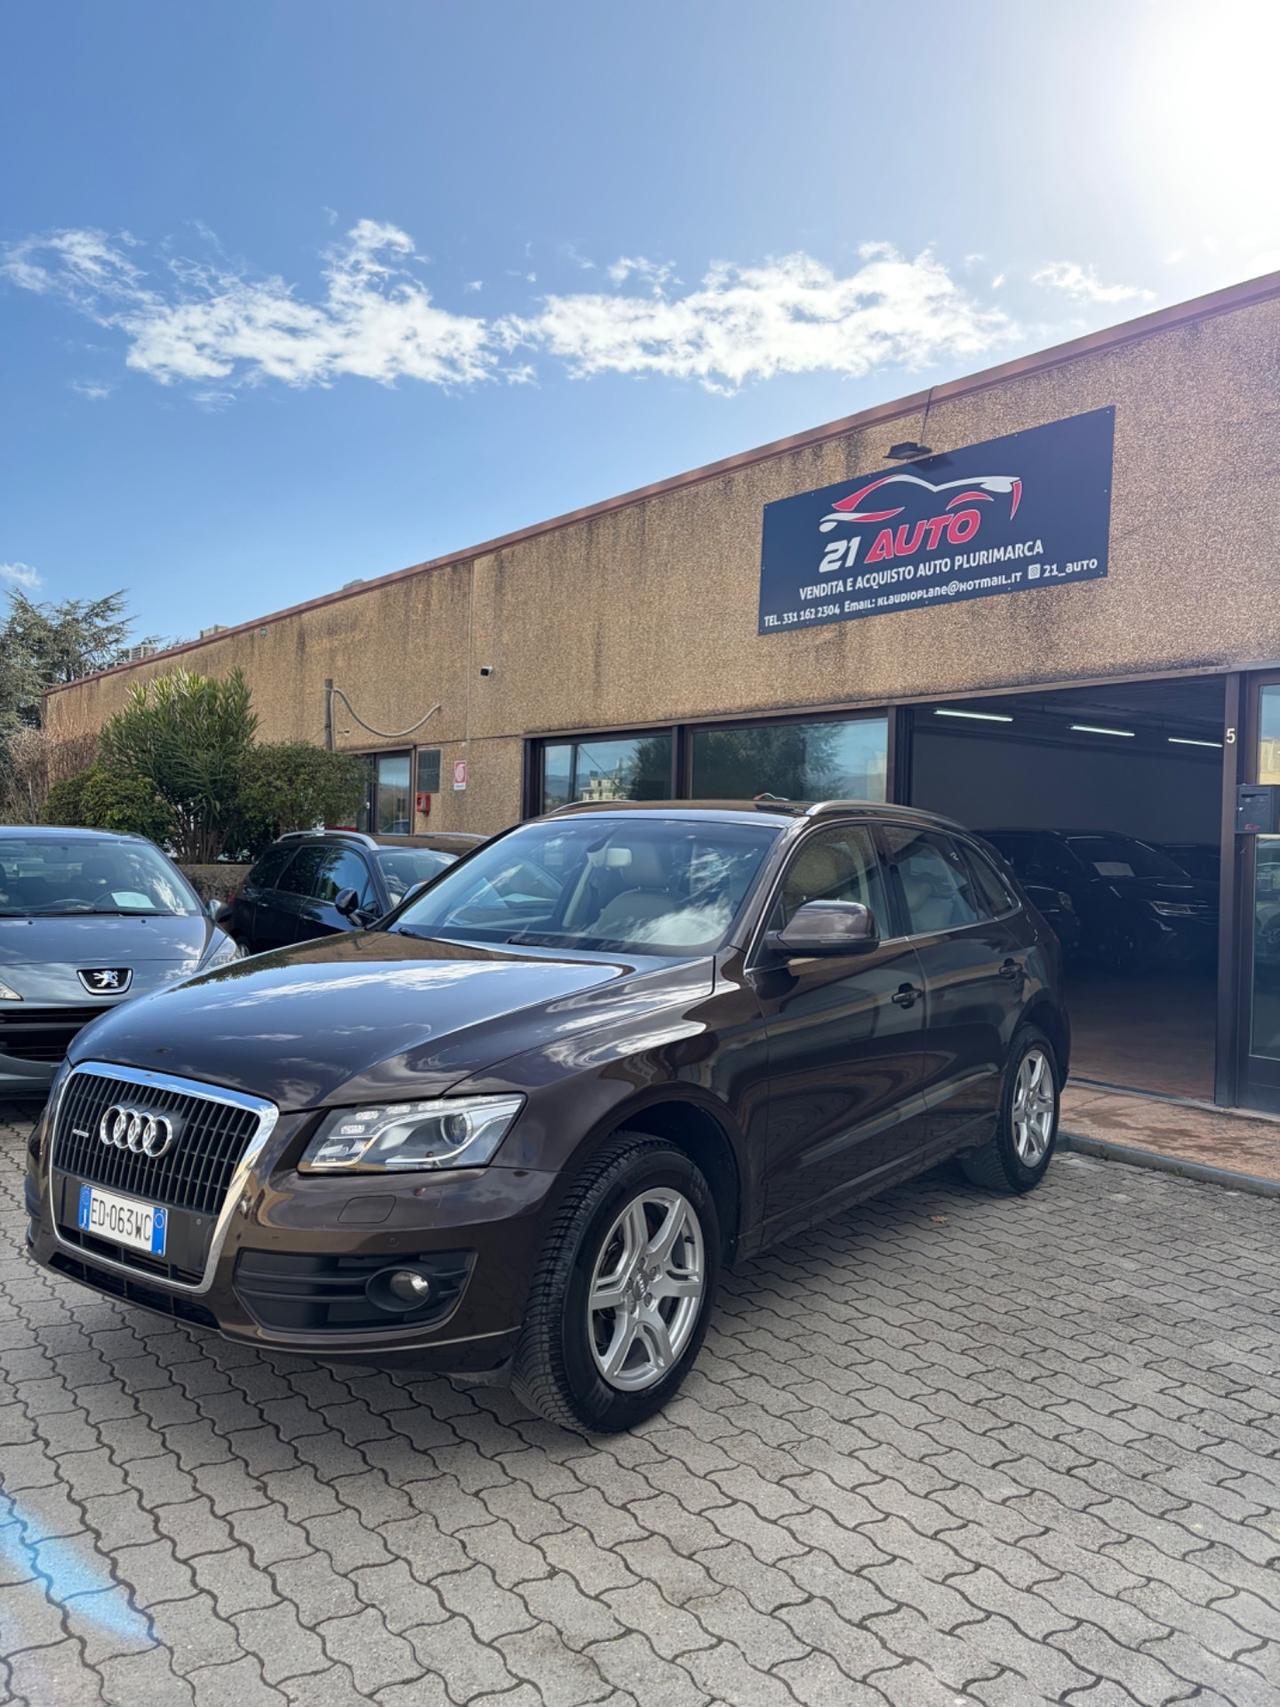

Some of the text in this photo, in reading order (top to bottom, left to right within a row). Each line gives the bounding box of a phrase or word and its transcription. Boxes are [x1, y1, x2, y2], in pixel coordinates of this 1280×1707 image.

[818, 508, 981, 573] 21 AUTO
[799, 538, 1044, 601] VENDITA E ACQUISTO AUTO PLURIMARCA
[763, 614, 781, 628] TEL.
[782, 612, 799, 625] 331
[800, 607, 816, 621] 162
[817, 603, 840, 618] 2304
[1226, 727, 1236, 744] 5
